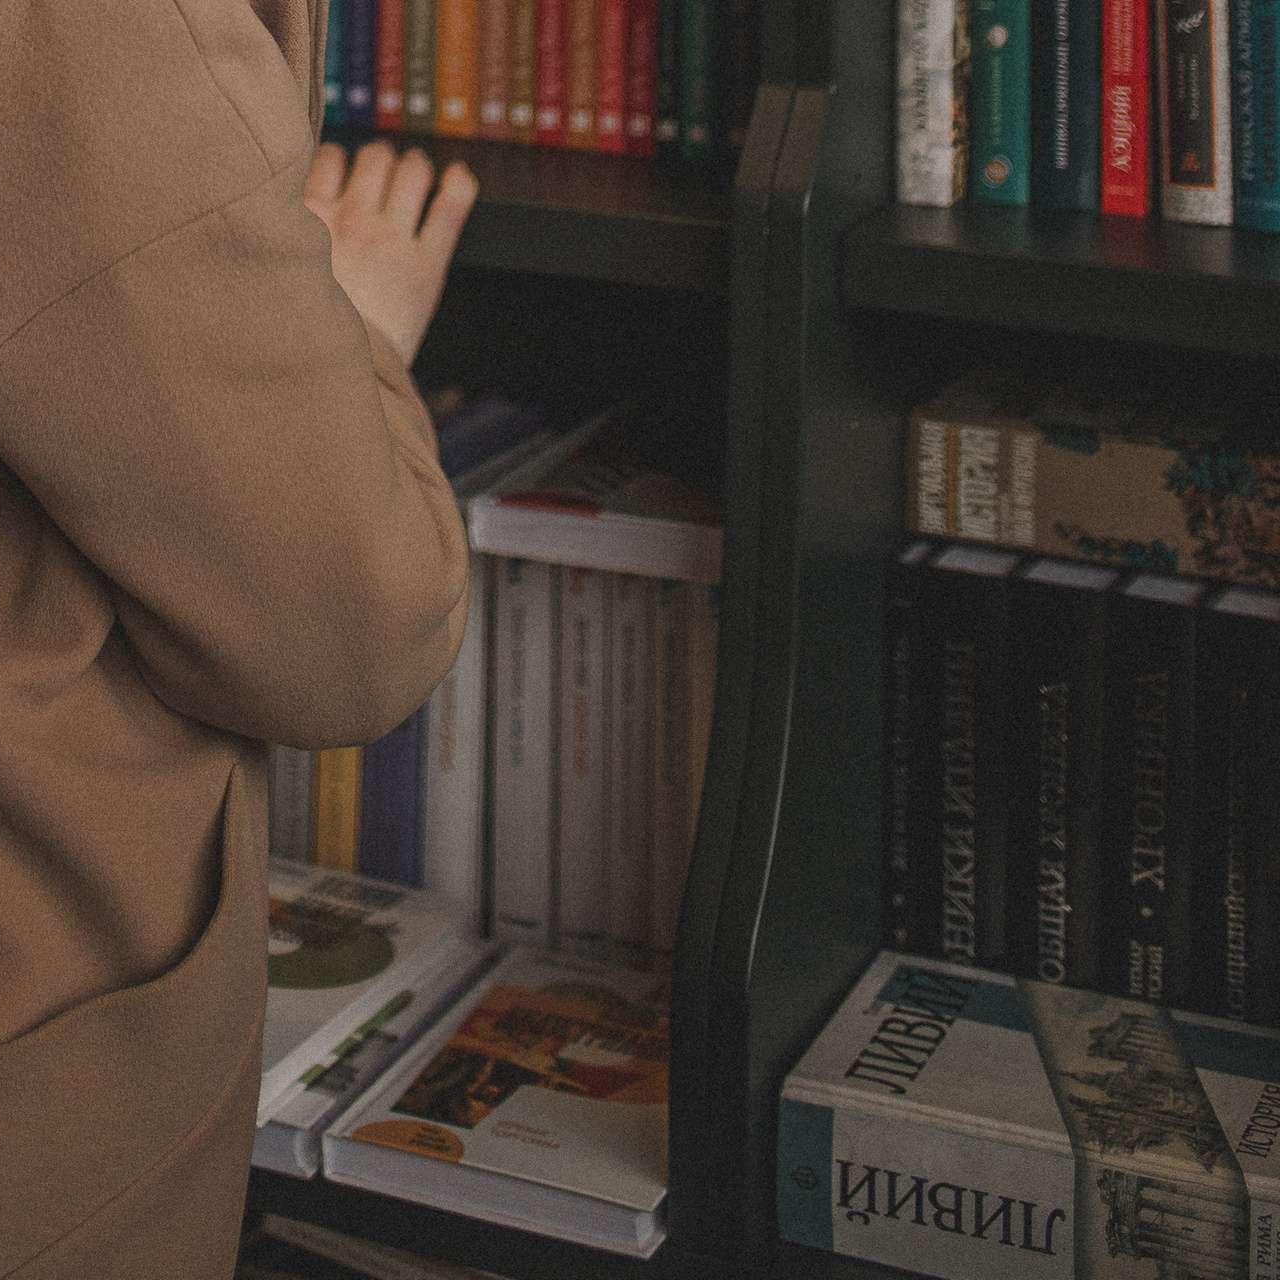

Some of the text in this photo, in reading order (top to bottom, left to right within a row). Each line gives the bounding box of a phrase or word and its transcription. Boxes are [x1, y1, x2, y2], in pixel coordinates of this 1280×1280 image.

[1129, 668, 1171, 892] ХРОНИКА
[1038, 859, 1073, 985] ОБЩАЯ
[843, 967, 981, 1095] ЛИВИЙ
[834, 1158, 1067, 1257] ЛИВИЙ
[1256, 1213, 1272, 1268] РИМА
